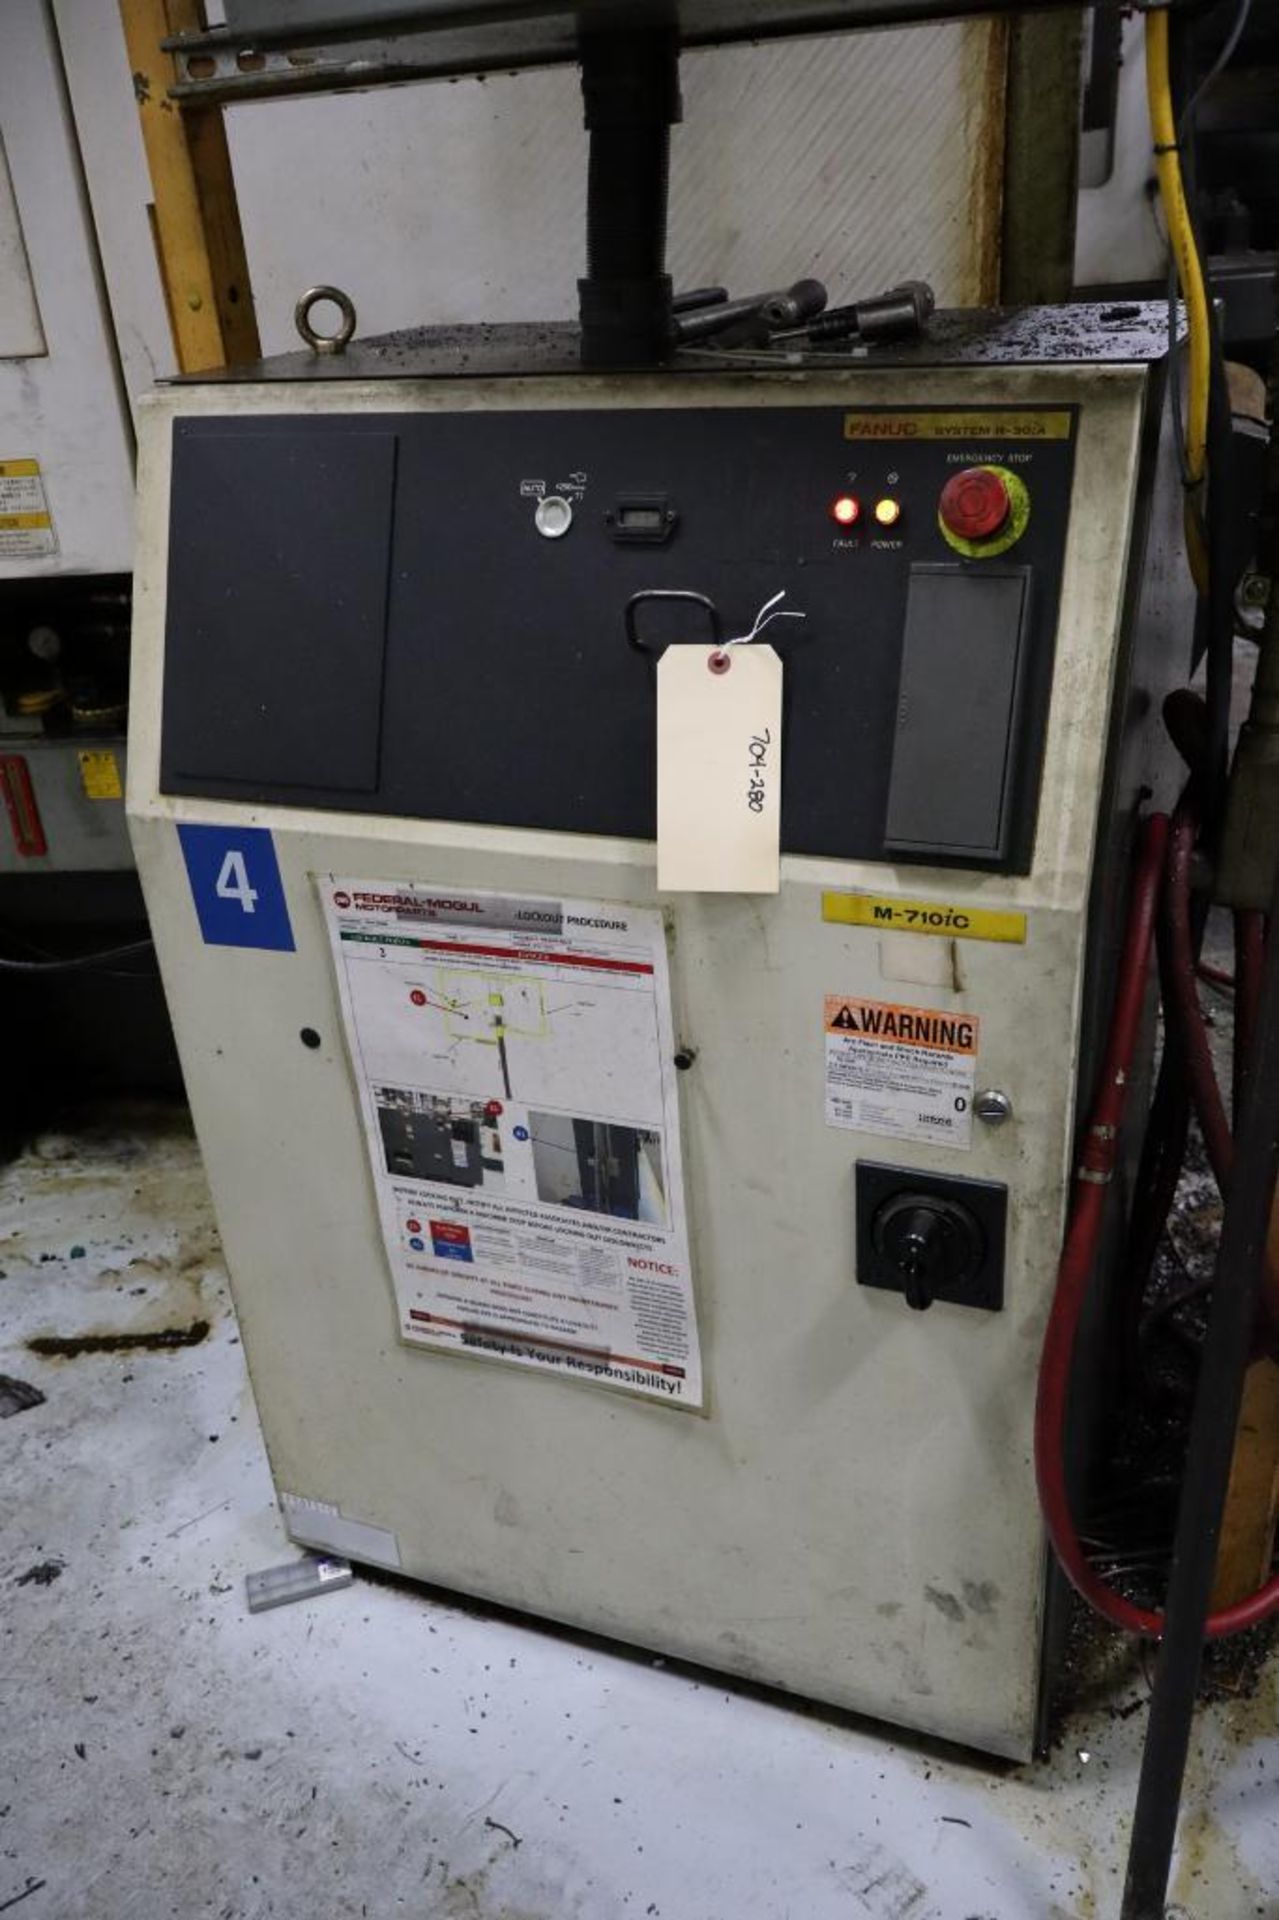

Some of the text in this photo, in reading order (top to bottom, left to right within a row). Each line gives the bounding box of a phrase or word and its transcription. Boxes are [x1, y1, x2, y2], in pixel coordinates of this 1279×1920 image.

[850, 422, 918, 436] FANUC
[934, 426, 991, 436] SYSTEM
[946, 454, 1034, 464] EMERGENCY STOP
[748, 728, 771, 814] 704-280
[216, 851, 259, 914] 4
[352, 892, 485, 914] FEDERAL-MOGUL
[567, 915, 628, 932] PROCEDURE
[873, 905, 970, 930] M-710iC
[861, 1007, 973, 1050] WARNING
[566, 1355, 682, 1394] Responsibility!
